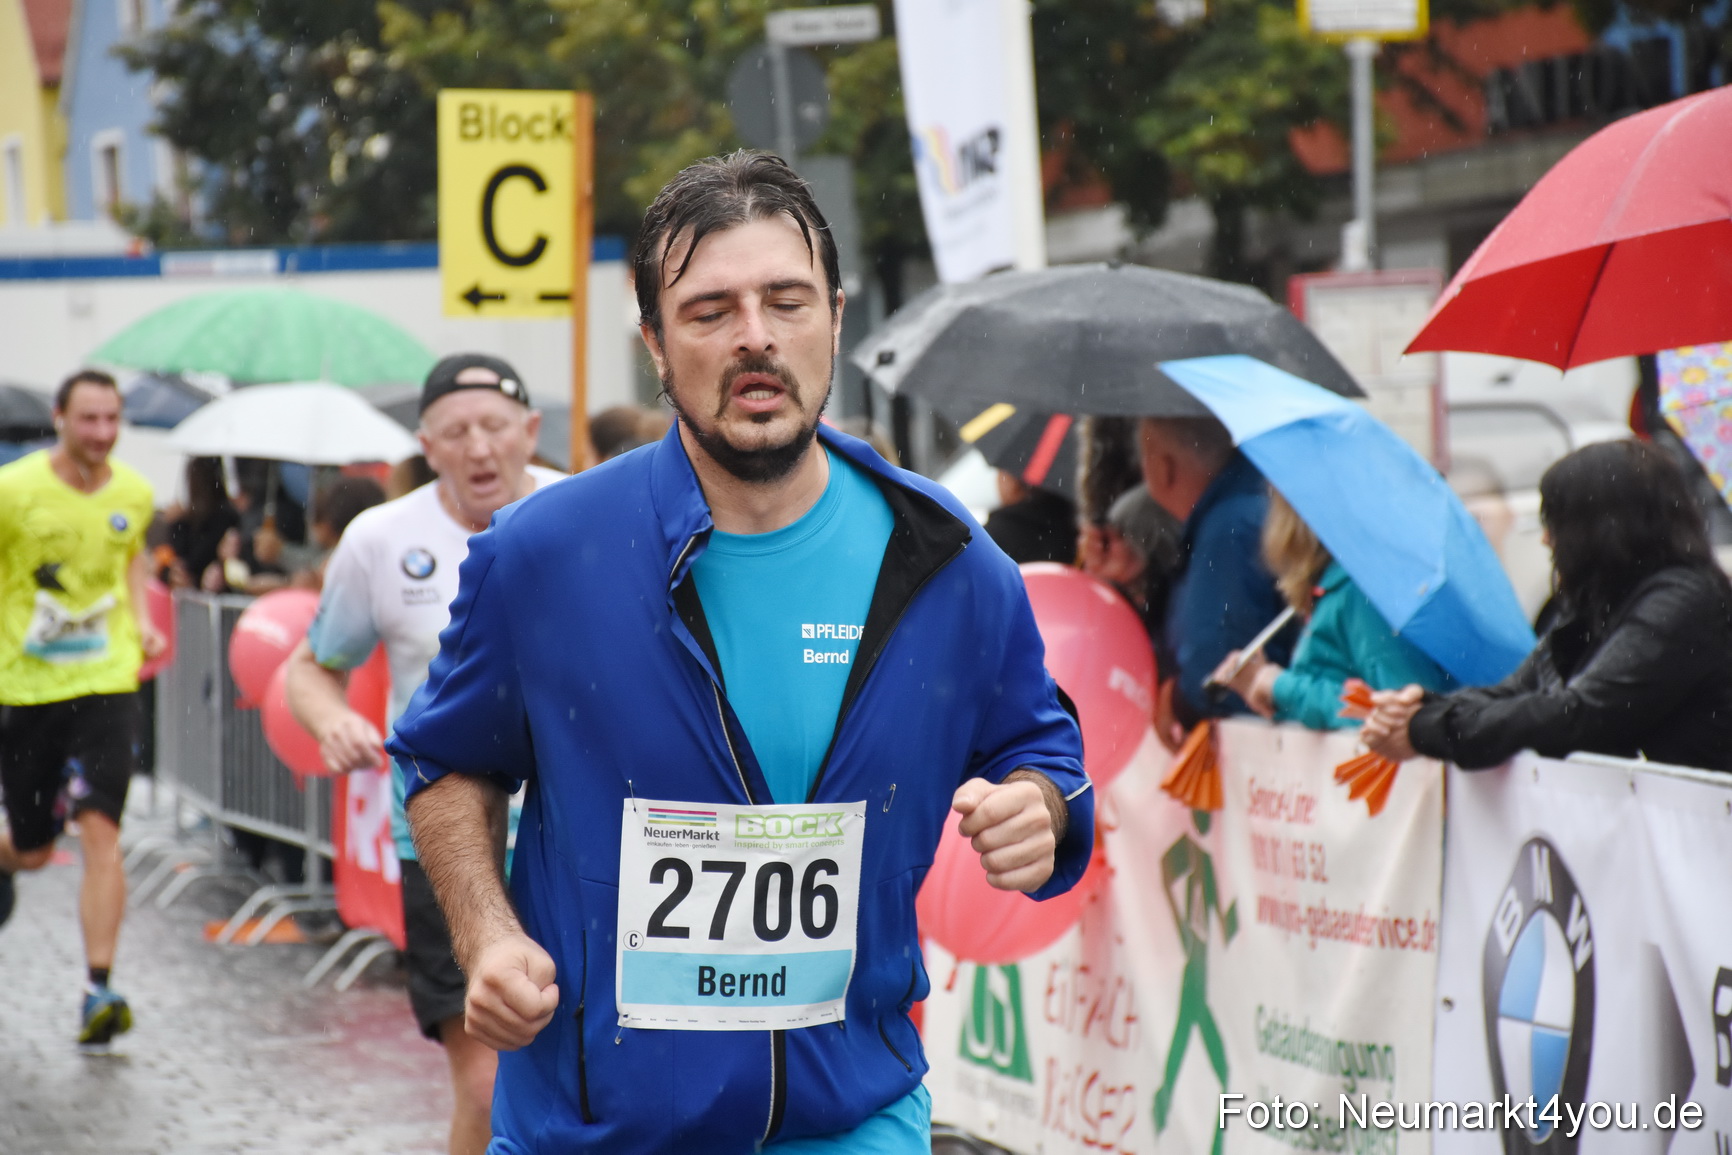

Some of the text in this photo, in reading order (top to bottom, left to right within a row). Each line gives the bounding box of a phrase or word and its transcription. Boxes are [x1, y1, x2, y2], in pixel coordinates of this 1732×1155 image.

[457, 102, 573, 143] Block
[480, 164, 547, 267] C
[803, 648, 849, 664] Bernd
[643, 826, 720, 841] NeuerMarkt
[735, 812, 845, 839] BOCK
[734, 838, 844, 850] inspired by smart concepts
[646, 857, 839, 942] 2706
[1494, 842, 1593, 973] BMW
[629, 933, 638, 948] C
[698, 966, 786, 997] Bernd
